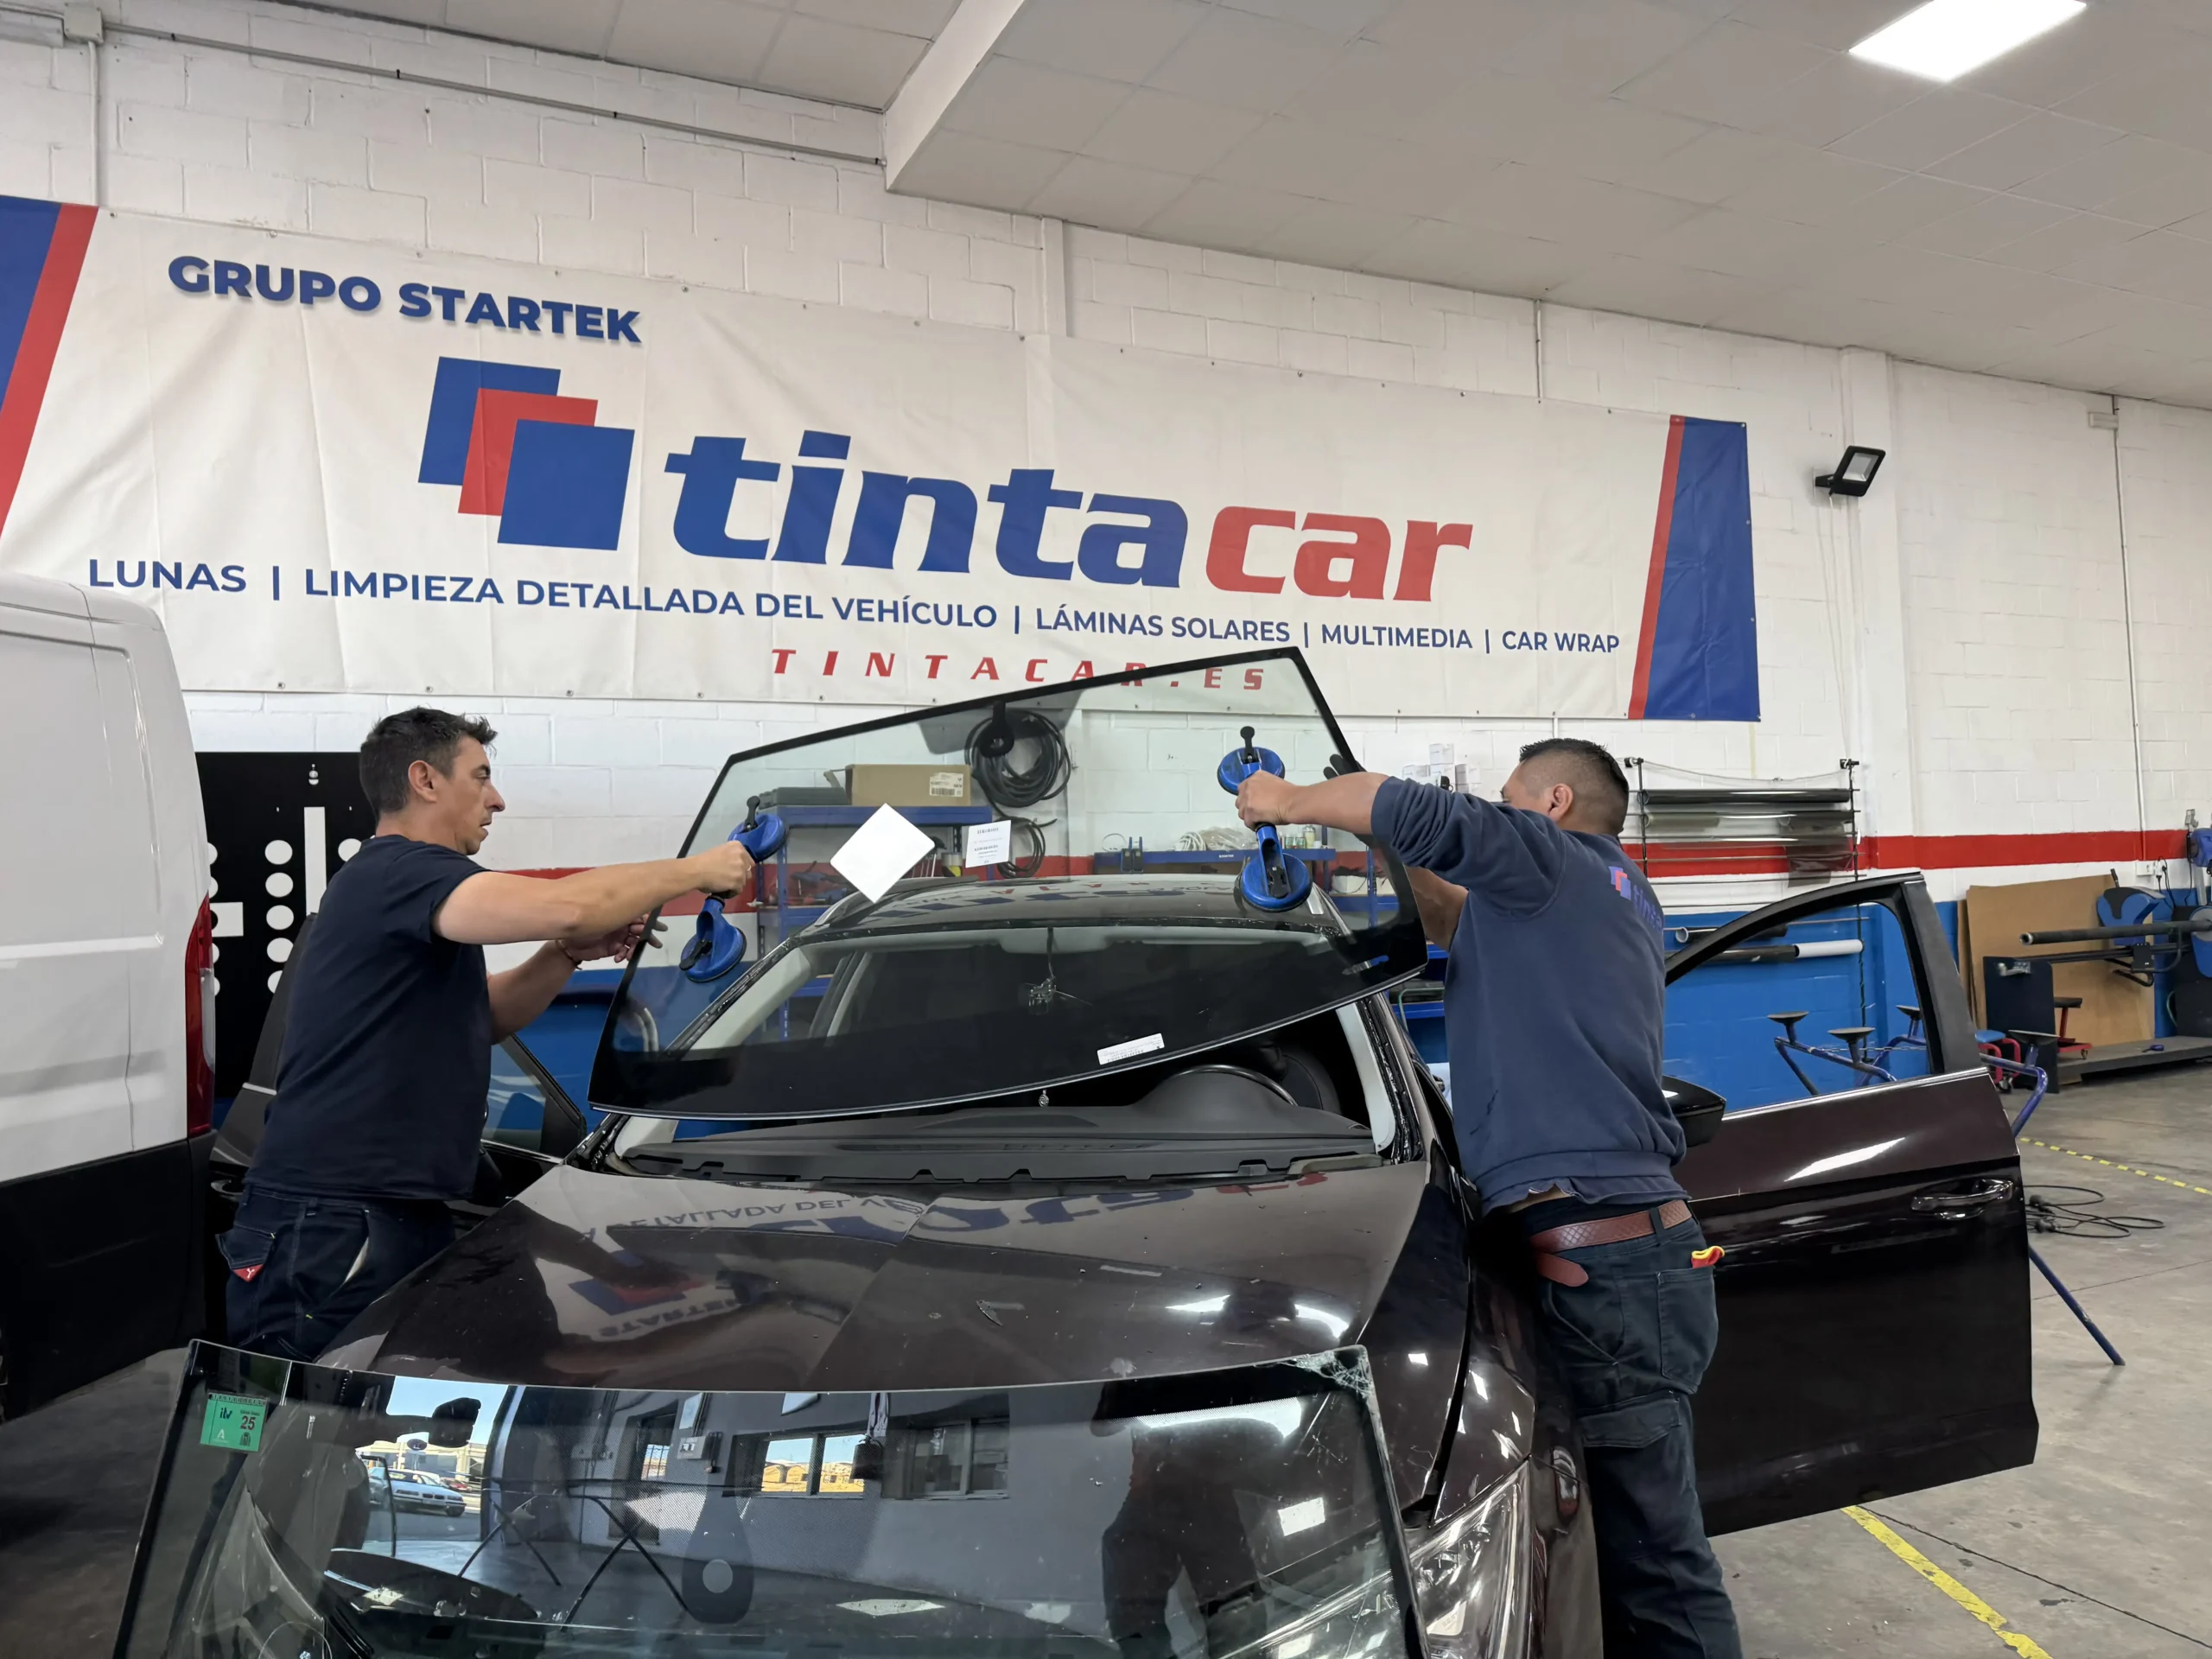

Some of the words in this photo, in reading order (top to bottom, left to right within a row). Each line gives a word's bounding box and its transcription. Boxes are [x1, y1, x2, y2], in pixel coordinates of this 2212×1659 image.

[168, 257, 382, 313] GRUPO
[398, 283, 642, 344] STARTEK
[89, 558, 247, 593] LUNAS
[305, 569, 504, 605] LIMPIEZA
[518, 580, 745, 616] DETALLADA
[756, 594, 823, 619] DEL
[833, 596, 997, 628] VEHÍCULO
[1036, 604, 1163, 636] LÁMINAS
[1172, 616, 1290, 642] SOLARES
[1321, 624, 1473, 650] MULTIMEDIA
[1502, 630, 1548, 651] CAR
[1554, 632, 1620, 653] WRAP
[219, 1407, 232, 1420] itv
[240, 1415, 256, 1431] 25
